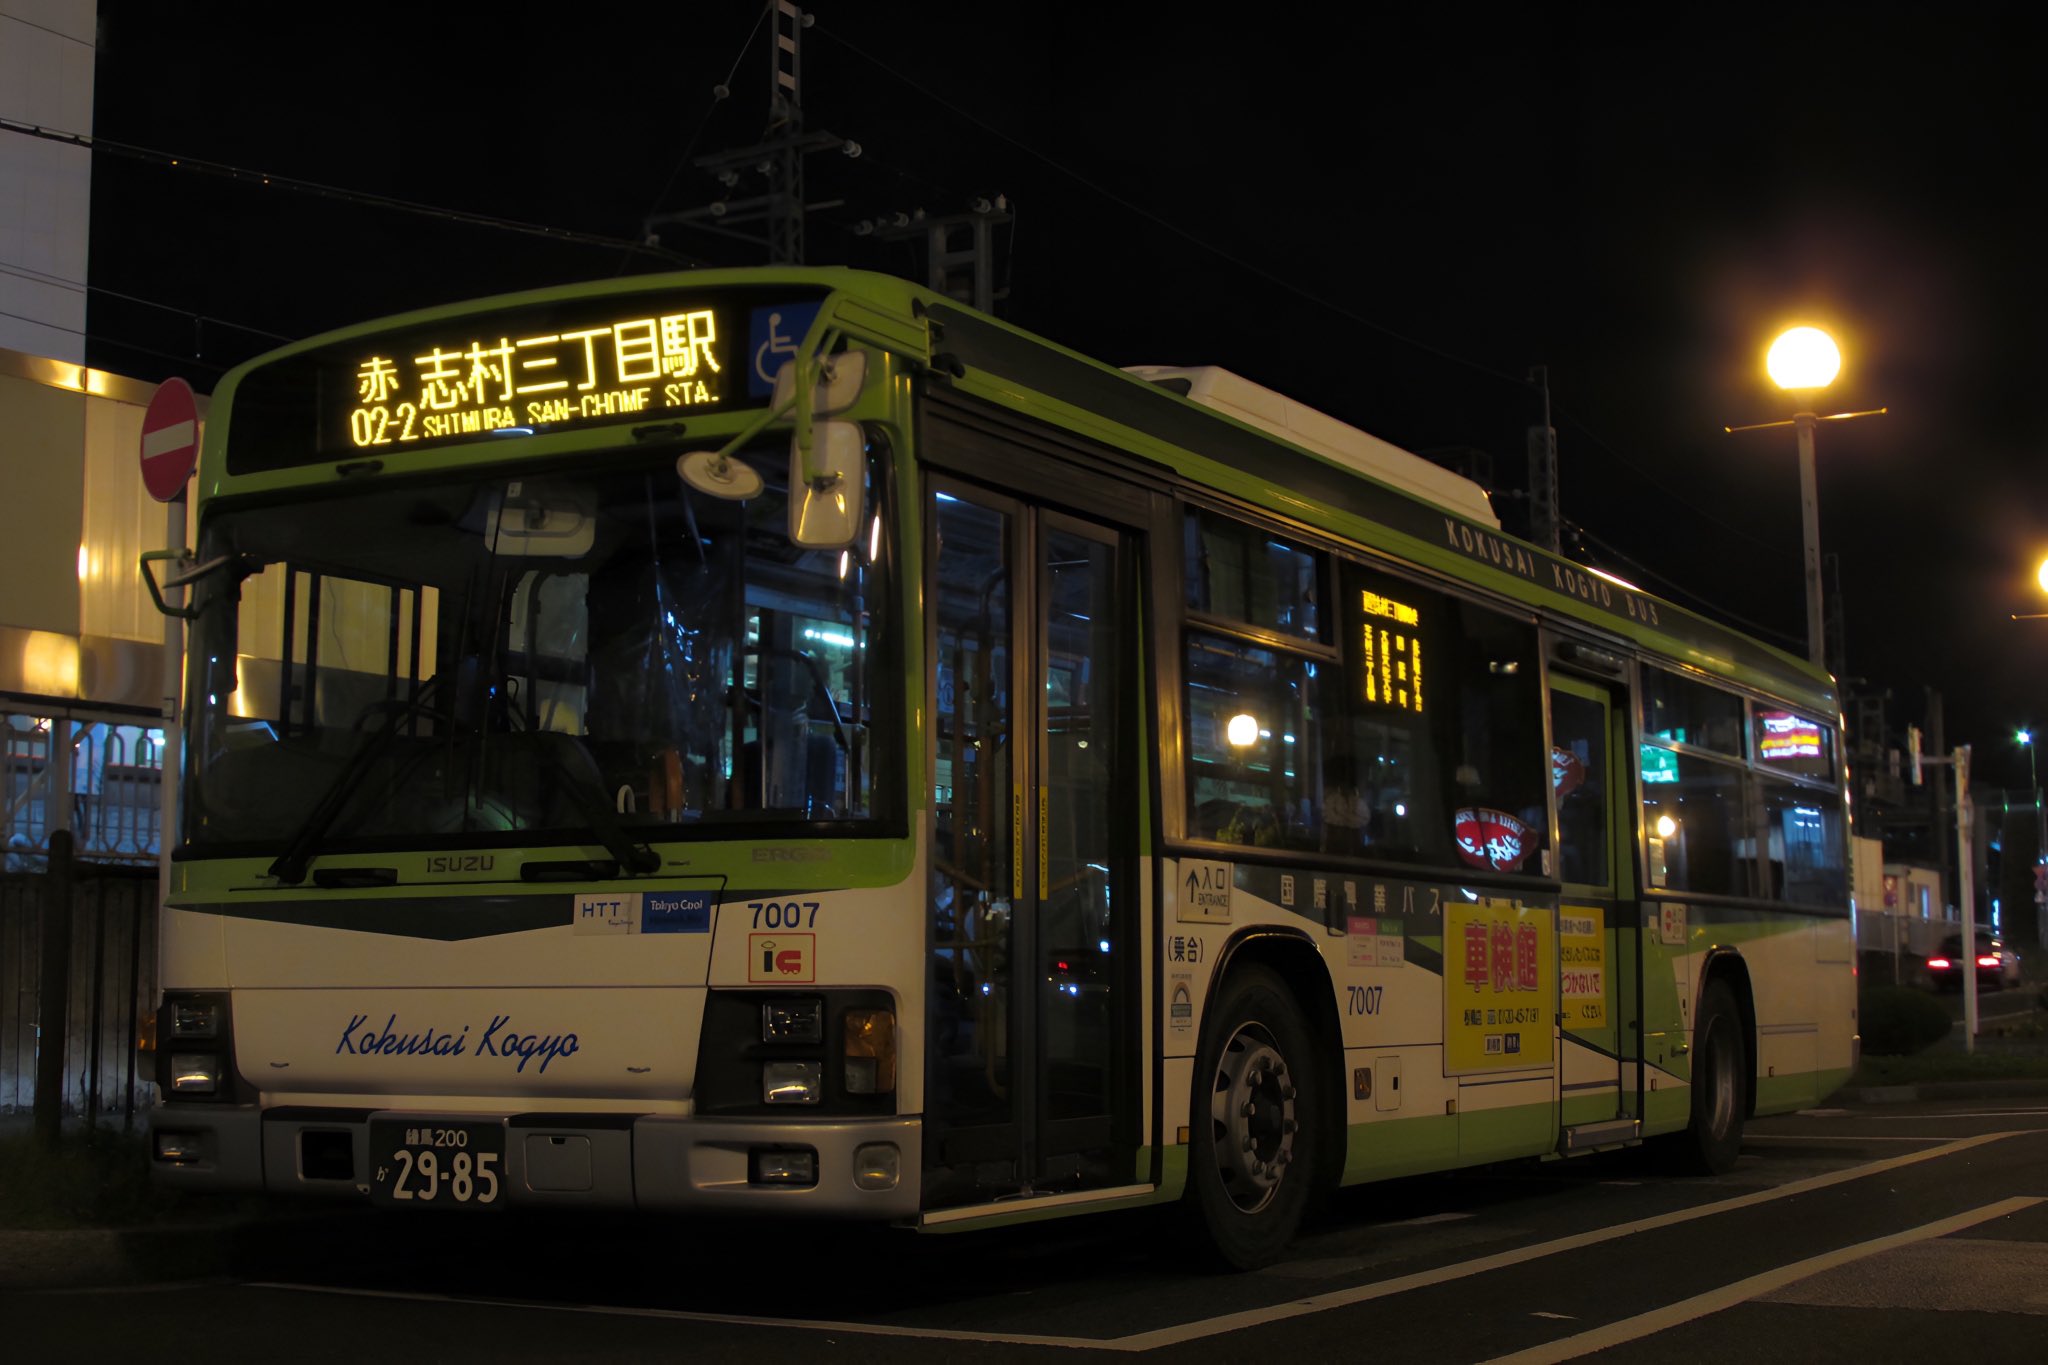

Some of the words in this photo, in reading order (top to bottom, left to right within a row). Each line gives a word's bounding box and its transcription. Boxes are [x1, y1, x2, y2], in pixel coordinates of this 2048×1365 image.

[357, 356, 399, 403] 赤
[414, 309, 720, 410] 志村三丁目駅
[351, 402, 418, 447] 02-2
[1444, 517, 1536, 578] KOKUSAI
[1551, 563, 1612, 608] KOGYO
[1625, 592, 1661, 627] BUS
[427, 855, 495, 873] ISUZU
[1201, 866, 1226, 890] 入口
[581, 901, 621, 918] HTT
[748, 902, 820, 929] 7007
[1347, 986, 1383, 1015] 7007
[335, 1013, 470, 1057] Kokusai
[474, 1014, 580, 1073] Kogyo
[392, 1148, 500, 1204] 29-85
